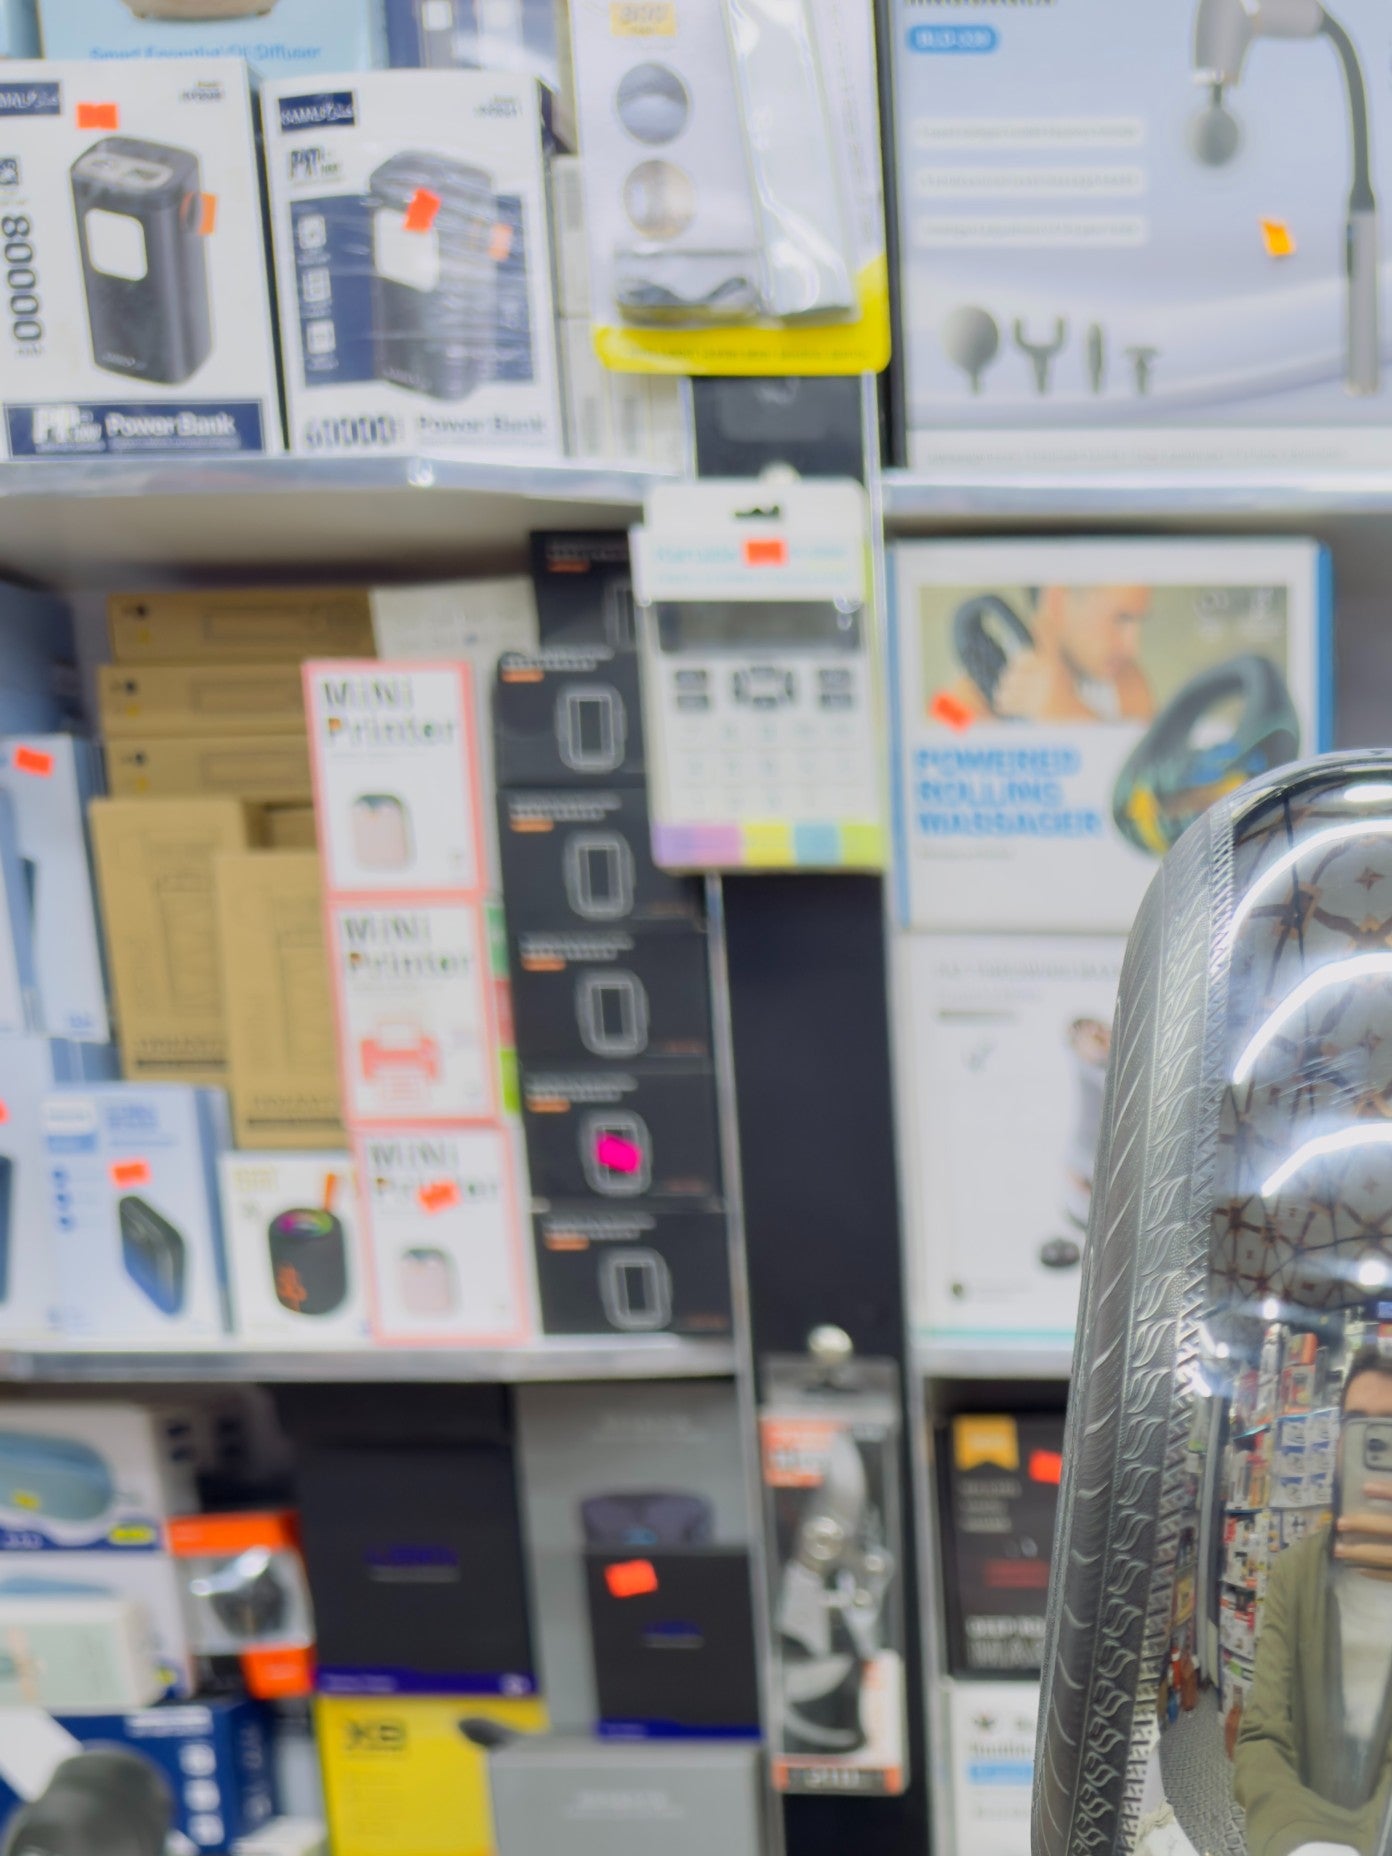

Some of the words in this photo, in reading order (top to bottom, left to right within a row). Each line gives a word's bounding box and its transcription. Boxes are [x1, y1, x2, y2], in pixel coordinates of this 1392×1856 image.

[107, 411, 179, 437] Power
[180, 411, 236, 437] Bank
[917, 747, 1082, 777] POWERED
[917, 779, 1067, 808] ROLLING
[917, 811, 1103, 839] MASSAGER
